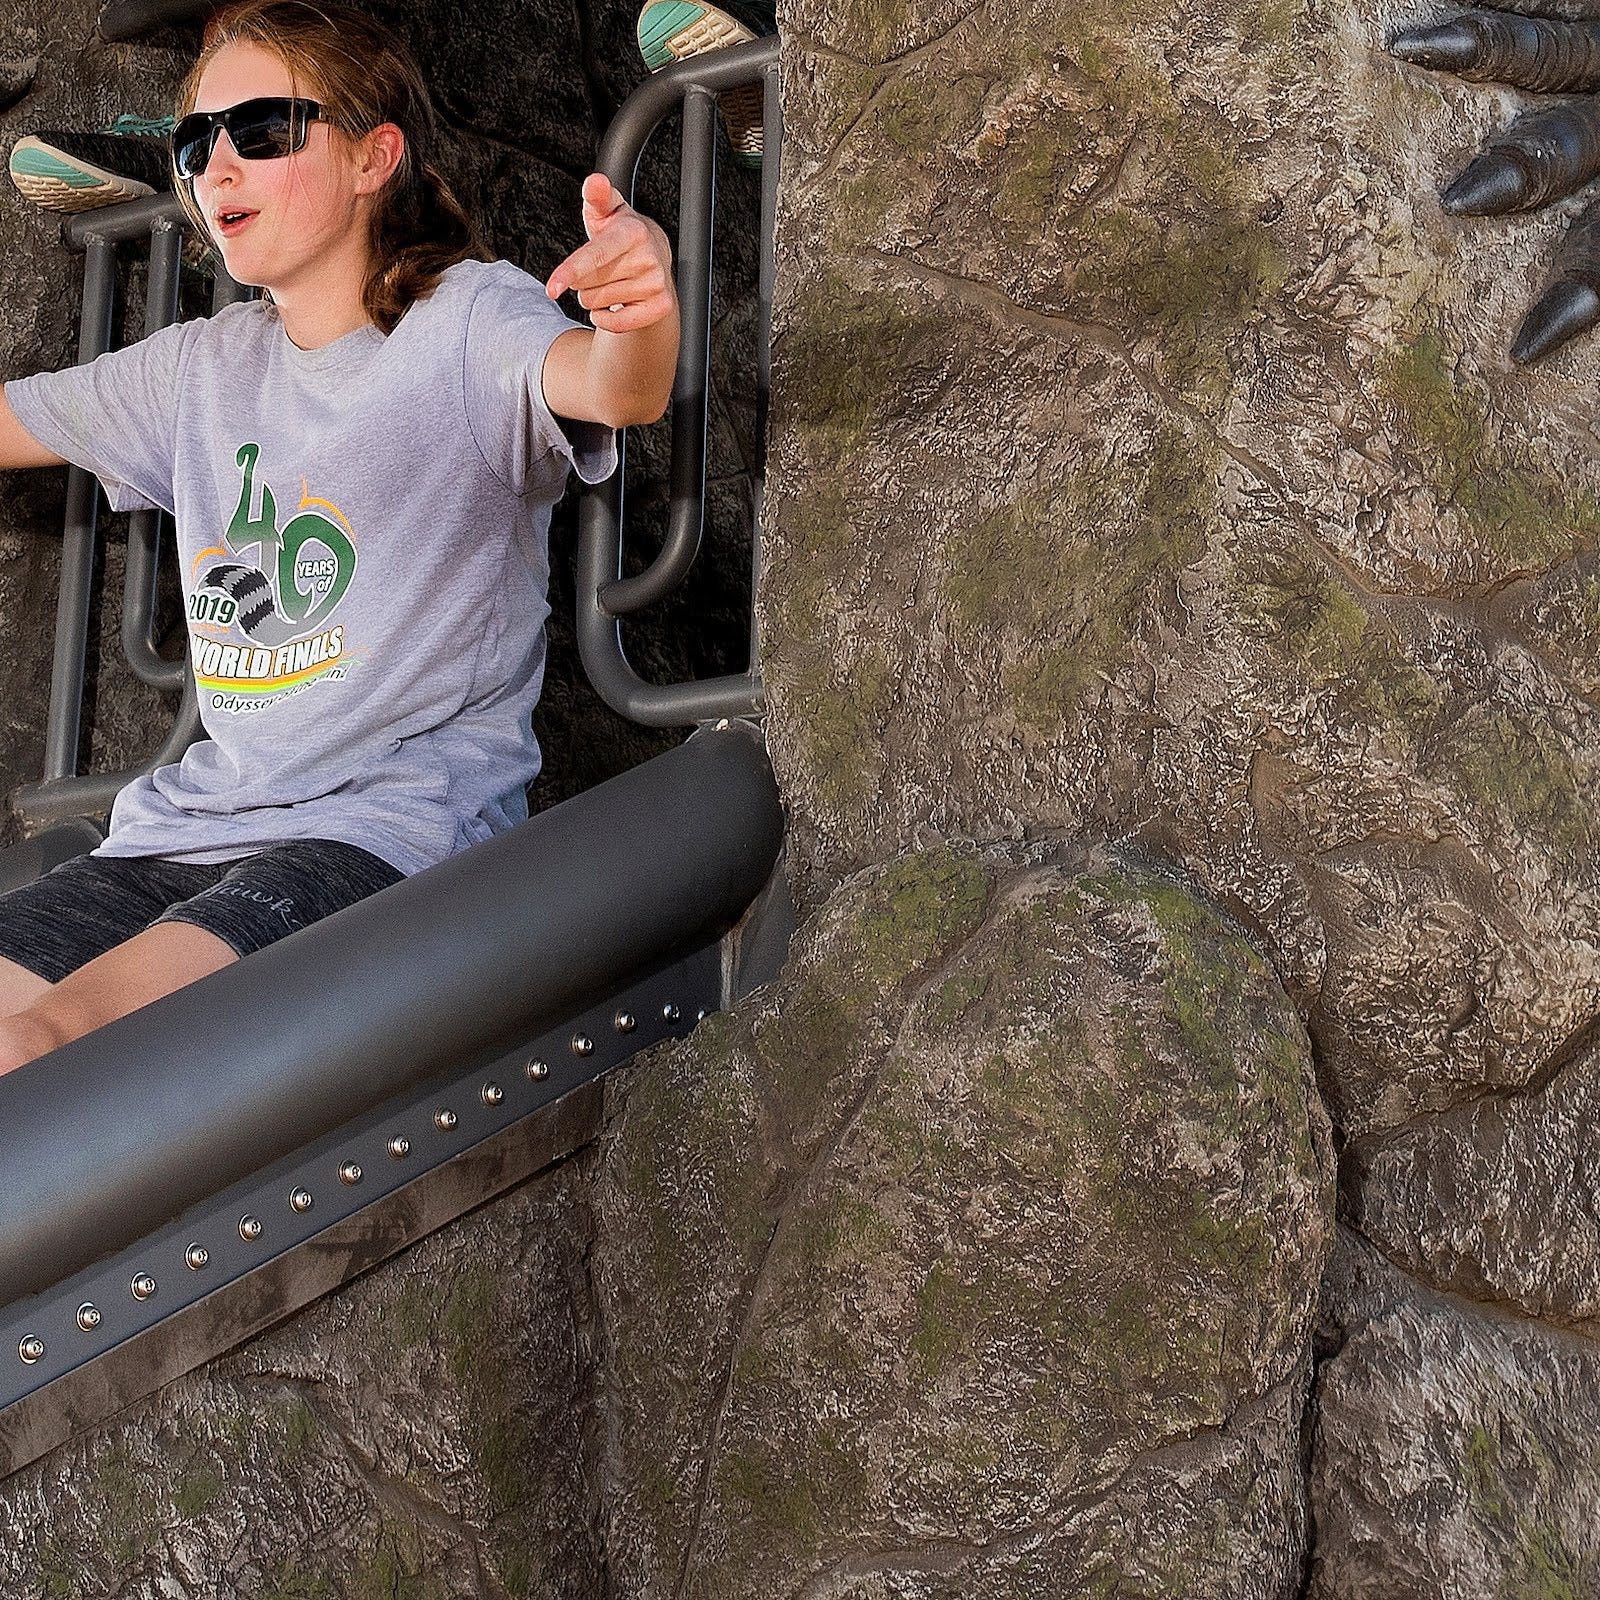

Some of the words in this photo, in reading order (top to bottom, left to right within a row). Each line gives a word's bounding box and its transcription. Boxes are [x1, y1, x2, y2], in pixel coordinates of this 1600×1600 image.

[298, 560, 335, 578] YEARS
[317, 578, 331, 593] of
[190, 594, 236, 624] 2019
[192, 633, 273, 679] WORLD
[273, 625, 344, 678] FINALS
